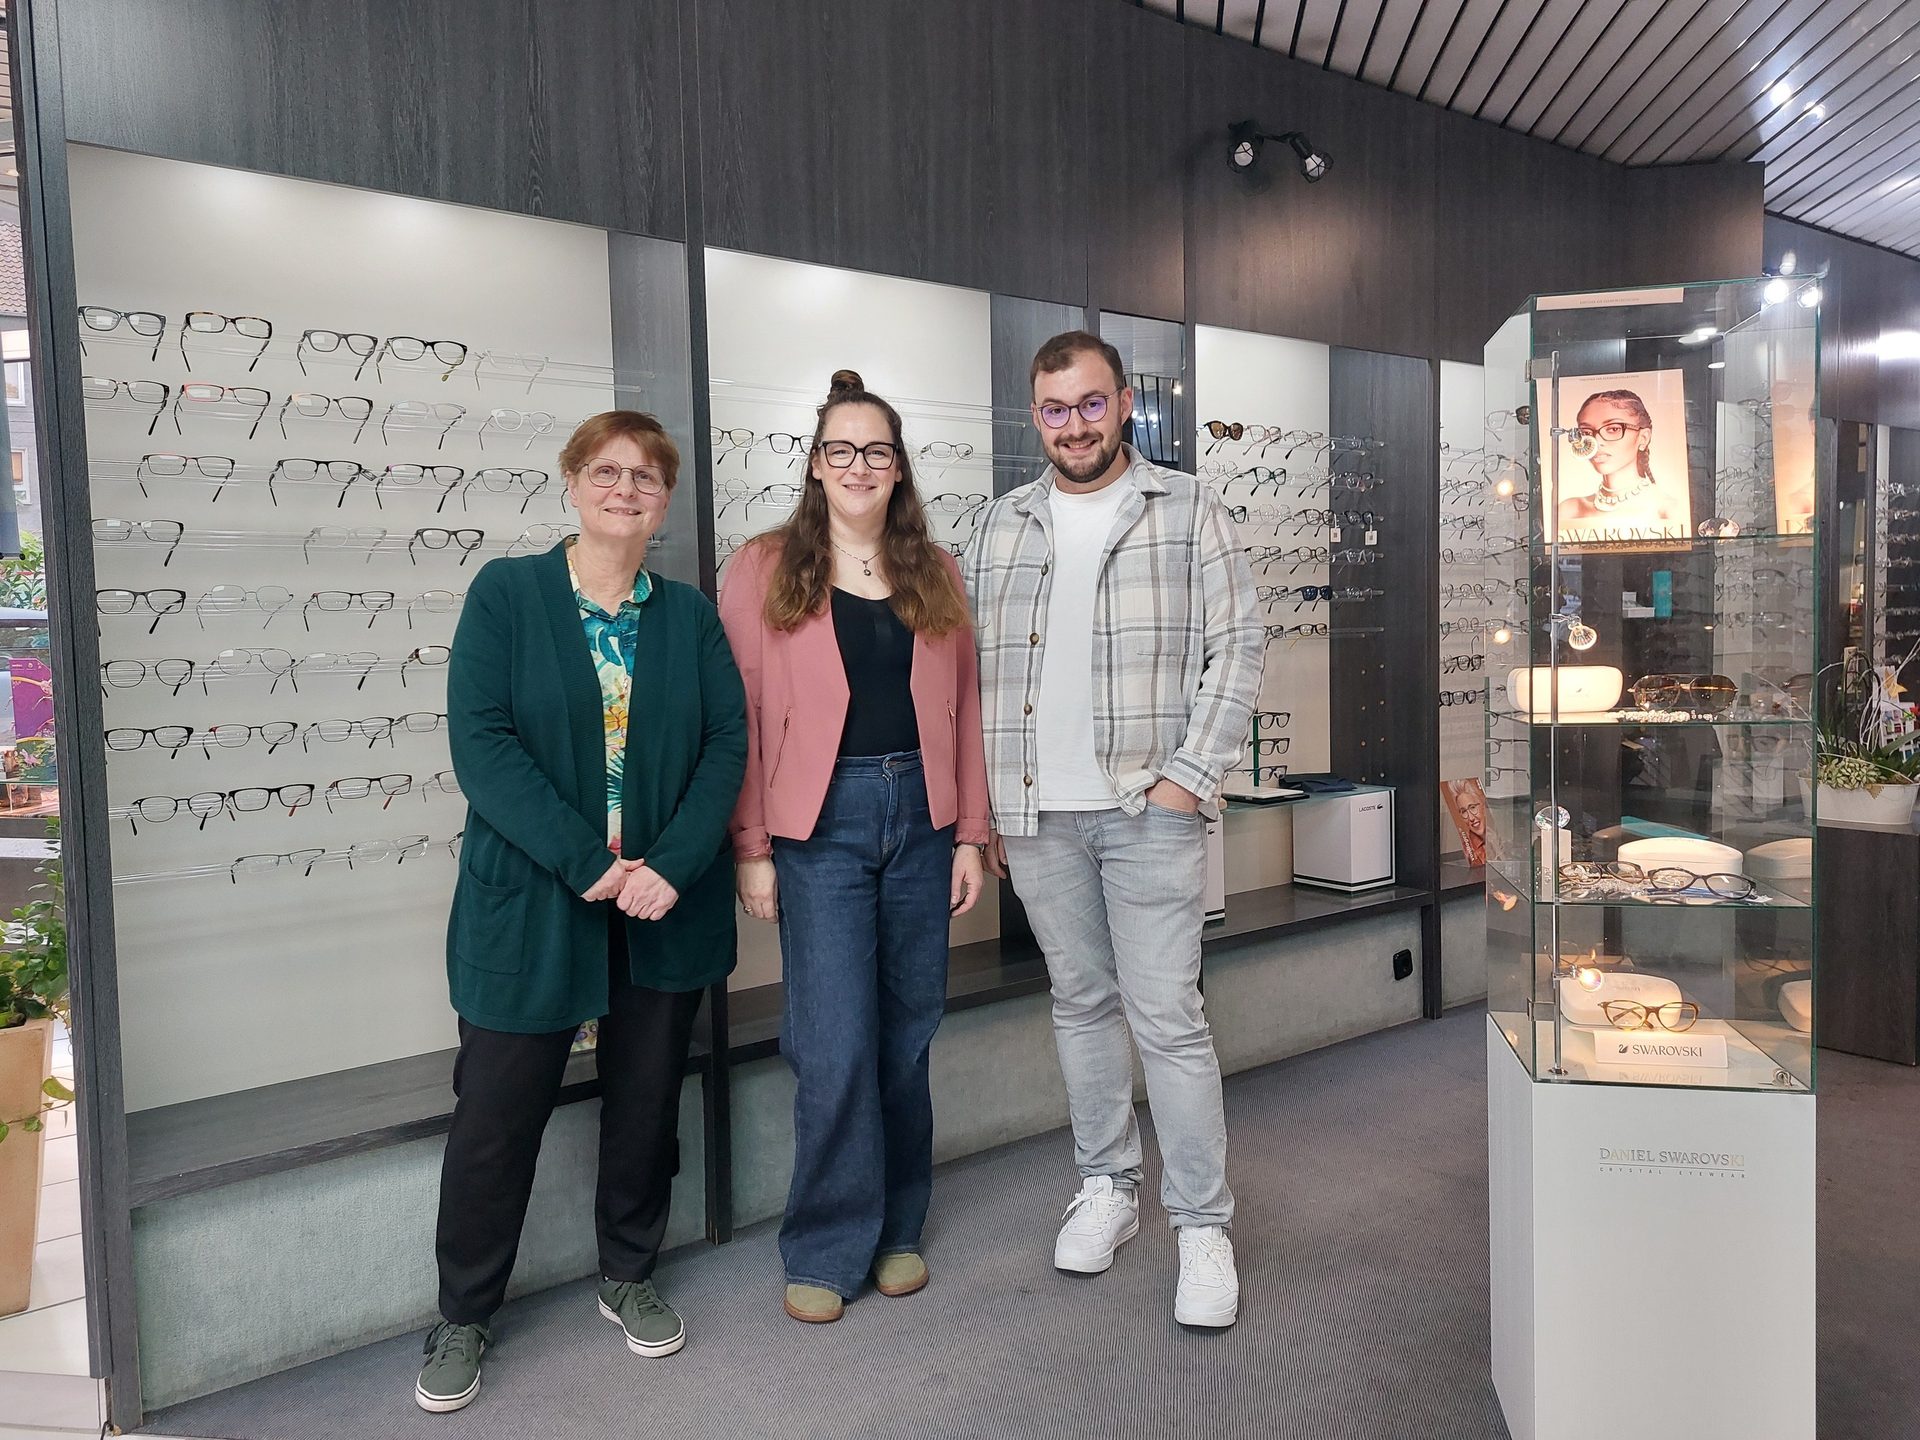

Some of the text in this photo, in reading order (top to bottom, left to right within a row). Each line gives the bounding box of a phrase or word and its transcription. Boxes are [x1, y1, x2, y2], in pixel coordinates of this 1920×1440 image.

[1632, 1044, 1703, 1057] SWAROVSKI
[1599, 1147, 1745, 1167] DANIEL SWAROVSKI
[1599, 1167, 1745, 1179] CRYSTAL EYEWEAR
